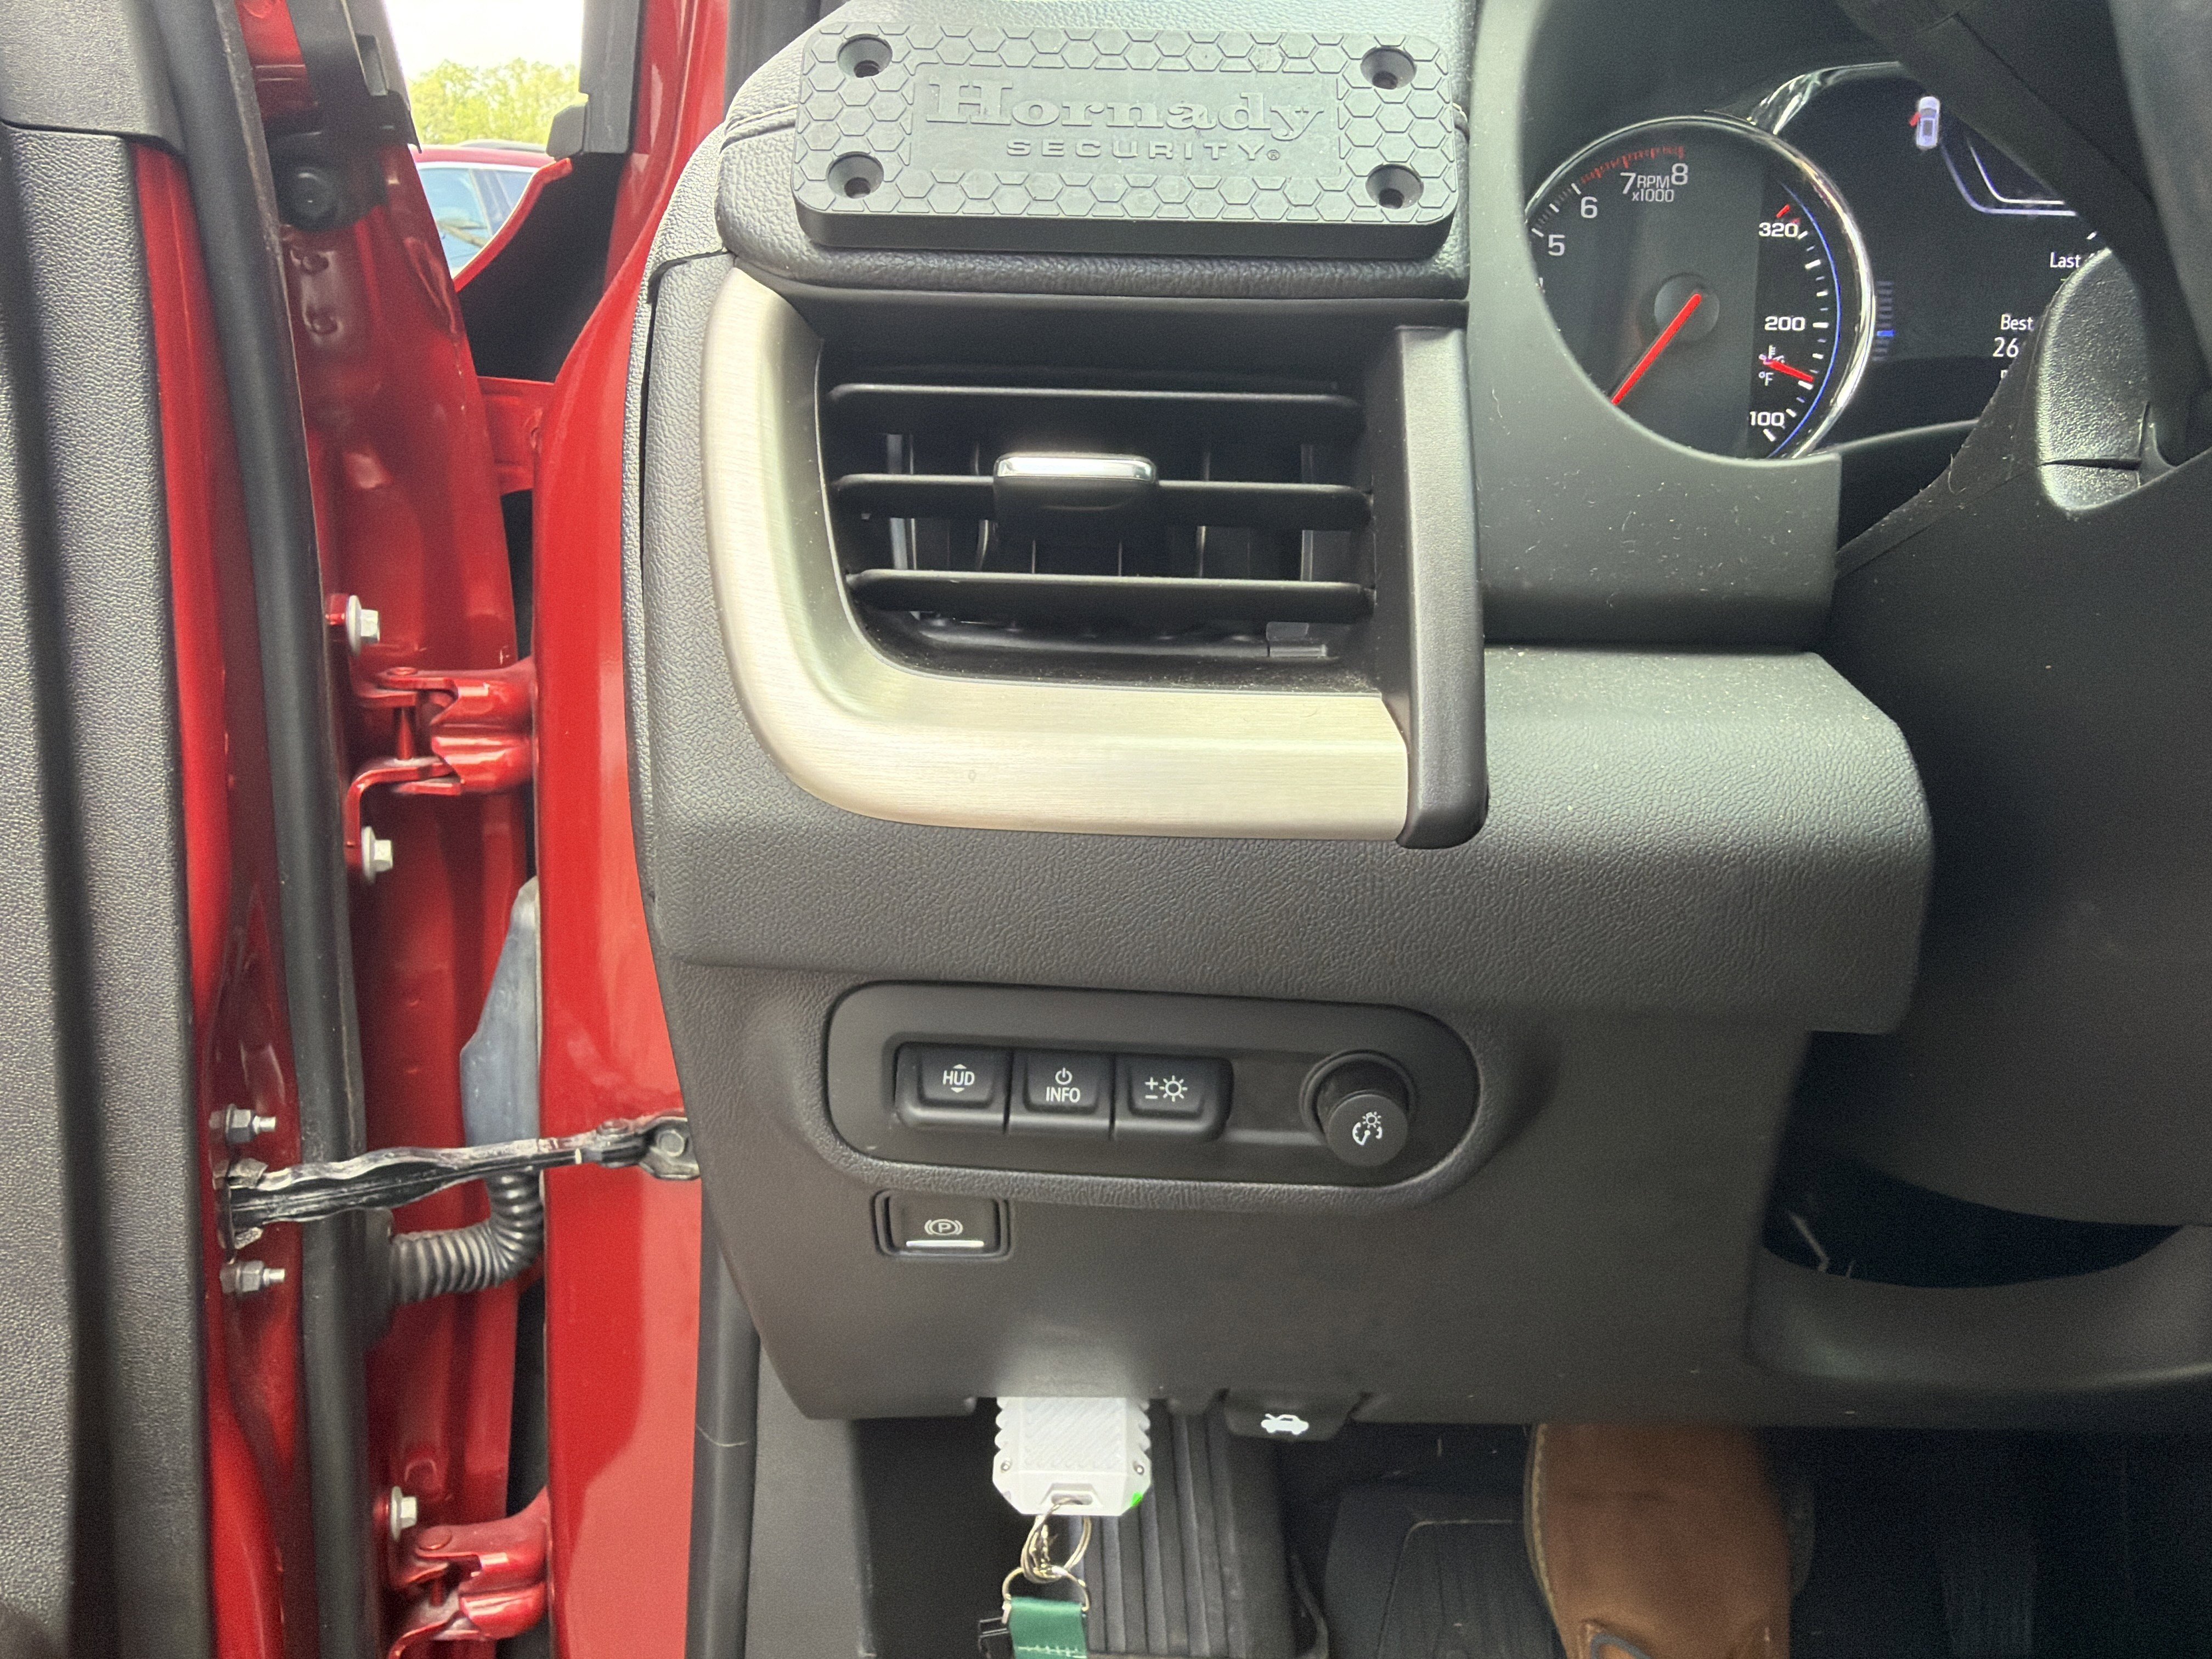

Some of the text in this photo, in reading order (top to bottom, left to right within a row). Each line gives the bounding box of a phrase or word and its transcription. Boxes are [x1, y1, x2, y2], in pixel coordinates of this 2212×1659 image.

[926, 81, 1324, 141] Hornady
[1637, 175, 1670, 189] RPM
[1671, 163, 1688, 185] 8
[1620, 172, 1636, 194] 7
[1581, 196, 1598, 218] 6
[1759, 222, 1798, 237] 320
[1548, 234, 1565, 256] 5
[2050, 252, 2081, 268] Last
[1764, 316, 1805, 331] 200
[2001, 314, 2034, 330] Best
[1750, 411, 1785, 426] 100
[943, 1070, 975, 1086] HUD
[1046, 1086, 1080, 1103] INFO
